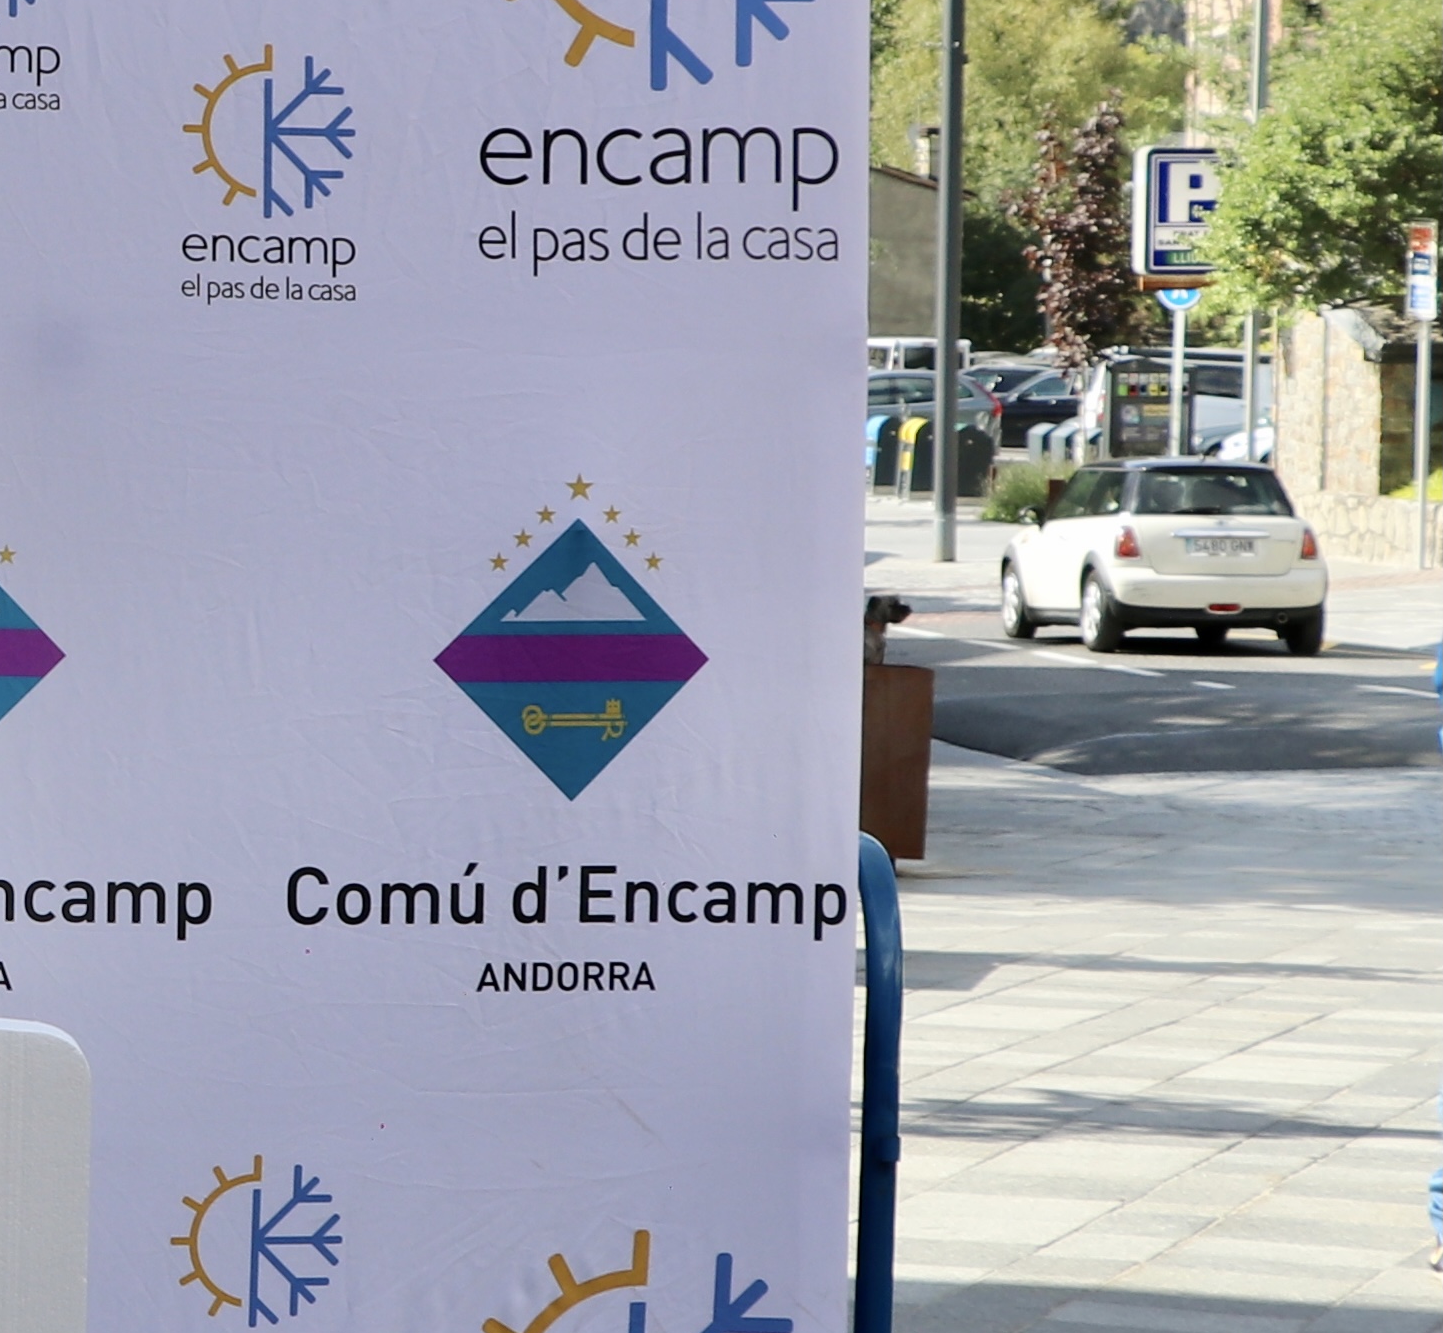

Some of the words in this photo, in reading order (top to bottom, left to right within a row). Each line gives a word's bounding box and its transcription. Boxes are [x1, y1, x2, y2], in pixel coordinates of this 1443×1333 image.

[11, 92, 61, 111] casa
[479, 126, 839, 212] encamp
[181, 233, 356, 279] encamp
[478, 210, 516, 260] el
[533, 227, 610, 277] pas
[622, 211, 682, 261] de
[697, 211, 730, 261] la
[742, 226, 839, 262] casa
[181, 273, 201, 297] el
[207, 281, 245, 306] pas
[249, 275, 280, 300] de
[285, 276, 303, 301] la
[307, 283, 357, 302] casa
[286, 862, 485, 926] Comú
[512, 865, 847, 942] d'Encamp
[475, 961, 656, 993] ANDORRA
